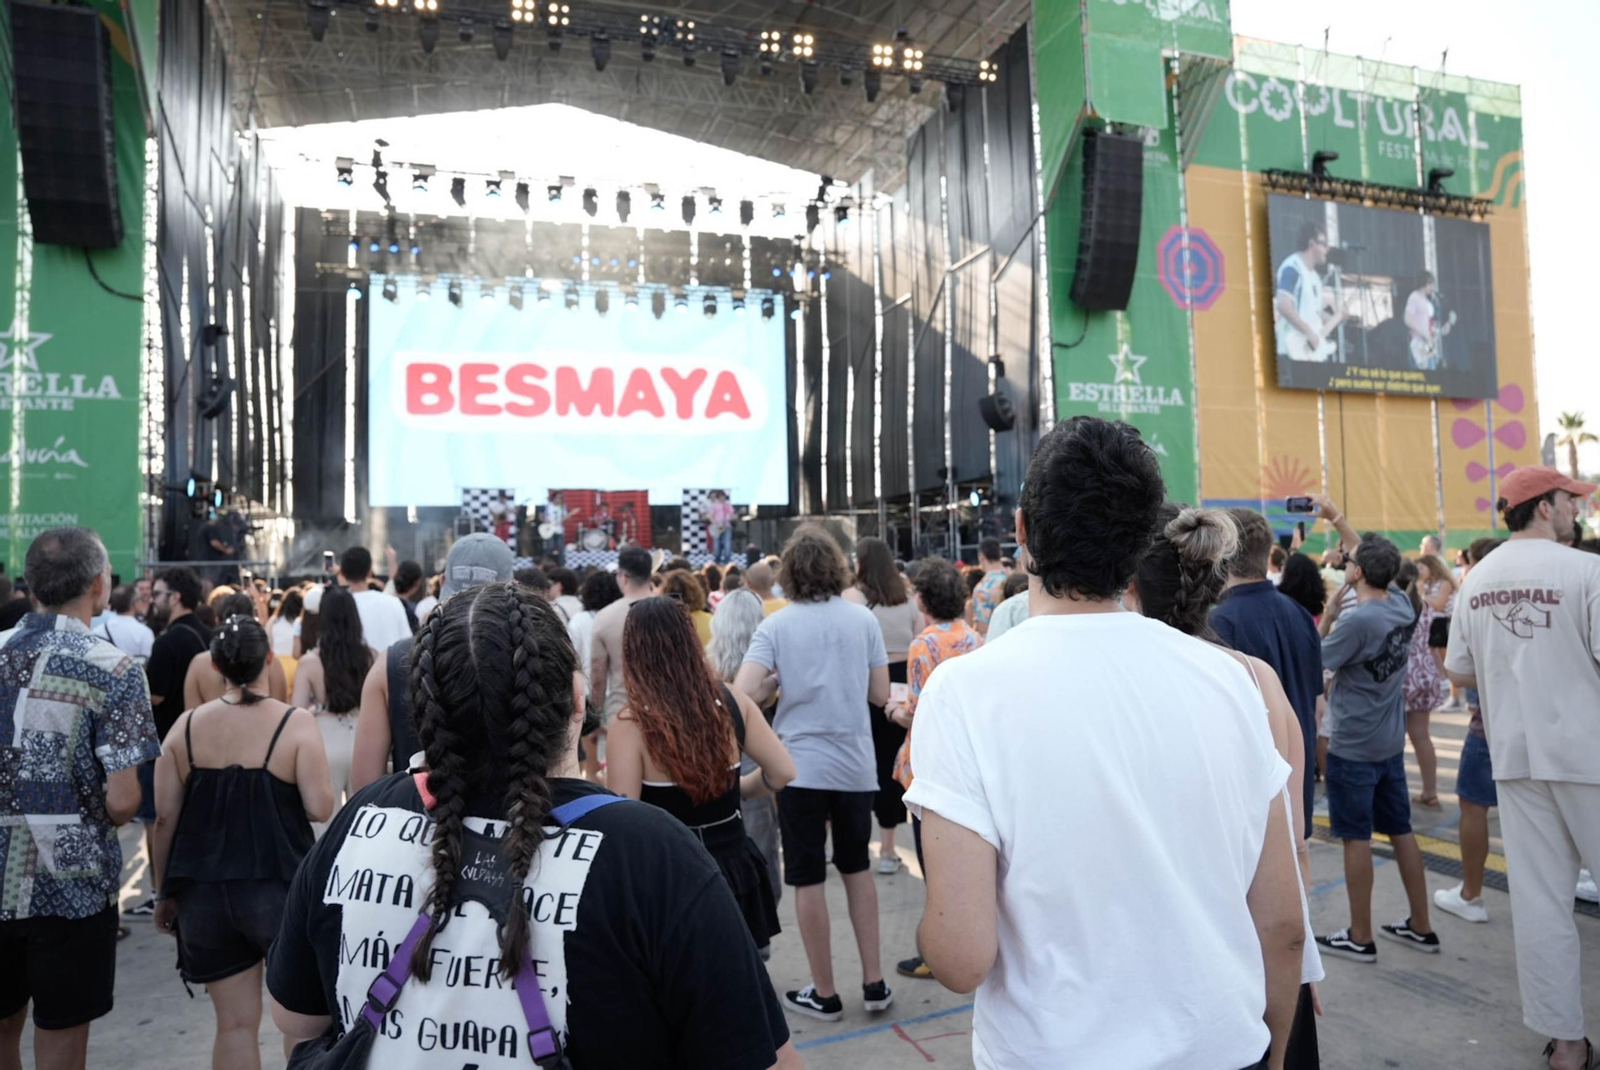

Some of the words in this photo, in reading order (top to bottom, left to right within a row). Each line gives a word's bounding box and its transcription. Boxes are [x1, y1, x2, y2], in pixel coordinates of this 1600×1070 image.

[1224, 70, 1489, 150] COOLTURAL
[0, 398, 74, 411] EANTE
[406, 362, 752, 420] BESMAYA
[1068, 382, 1184, 406] ESTRELLA
[1470, 589, 1560, 610] ORIGINAL
[350, 809, 387, 839] LO
[553, 831, 600, 863] TE
[327, 864, 414, 909] MATA
[340, 930, 404, 971] MÁ
[427, 947, 558, 999] FUERE,
[417, 1017, 518, 1059] GUAPA
